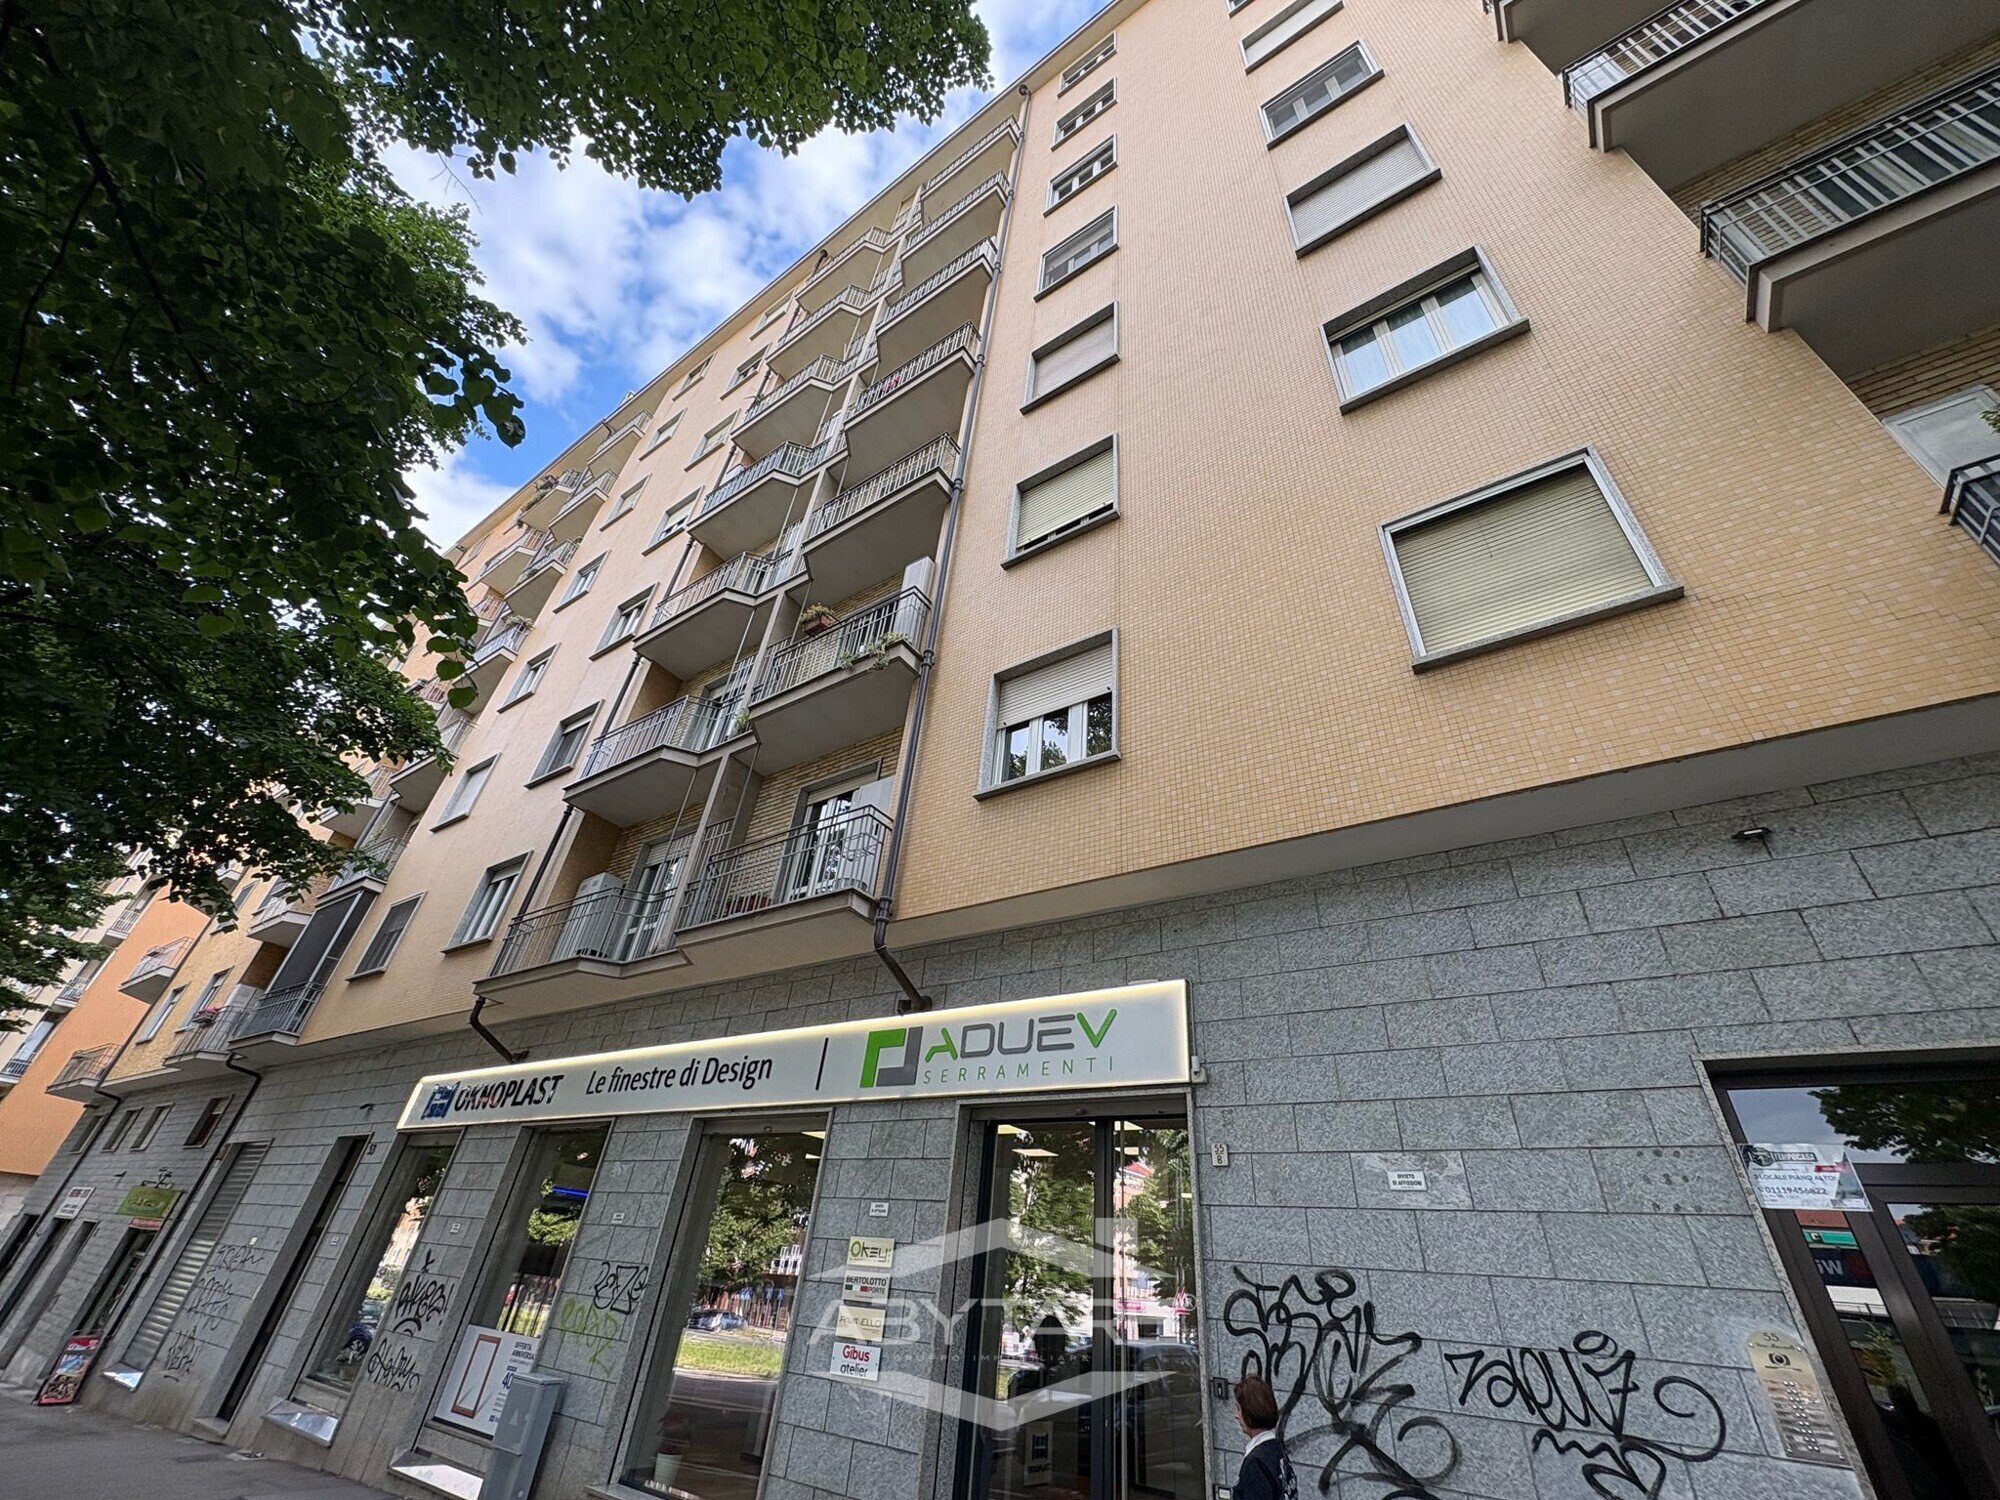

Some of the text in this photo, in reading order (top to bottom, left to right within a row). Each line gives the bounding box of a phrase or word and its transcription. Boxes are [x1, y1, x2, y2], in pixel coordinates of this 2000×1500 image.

[924, 1008, 1117, 1063] ADUEV
[586, 1055, 773, 1095] Le finestre di Design
[923, 1056, 1113, 1084] SERRAMENTI
[454, 1074, 565, 1111] OKNOPLAST
[1214, 1144, 1225, 1153] 55
[845, 1275, 887, 1287] BERTOLOTTO
[868, 1286, 887, 1295] PORTE
[1763, 1332, 1780, 1341] 55
[842, 1345, 870, 1362] Gibus
[840, 1363, 868, 1377] atelier
